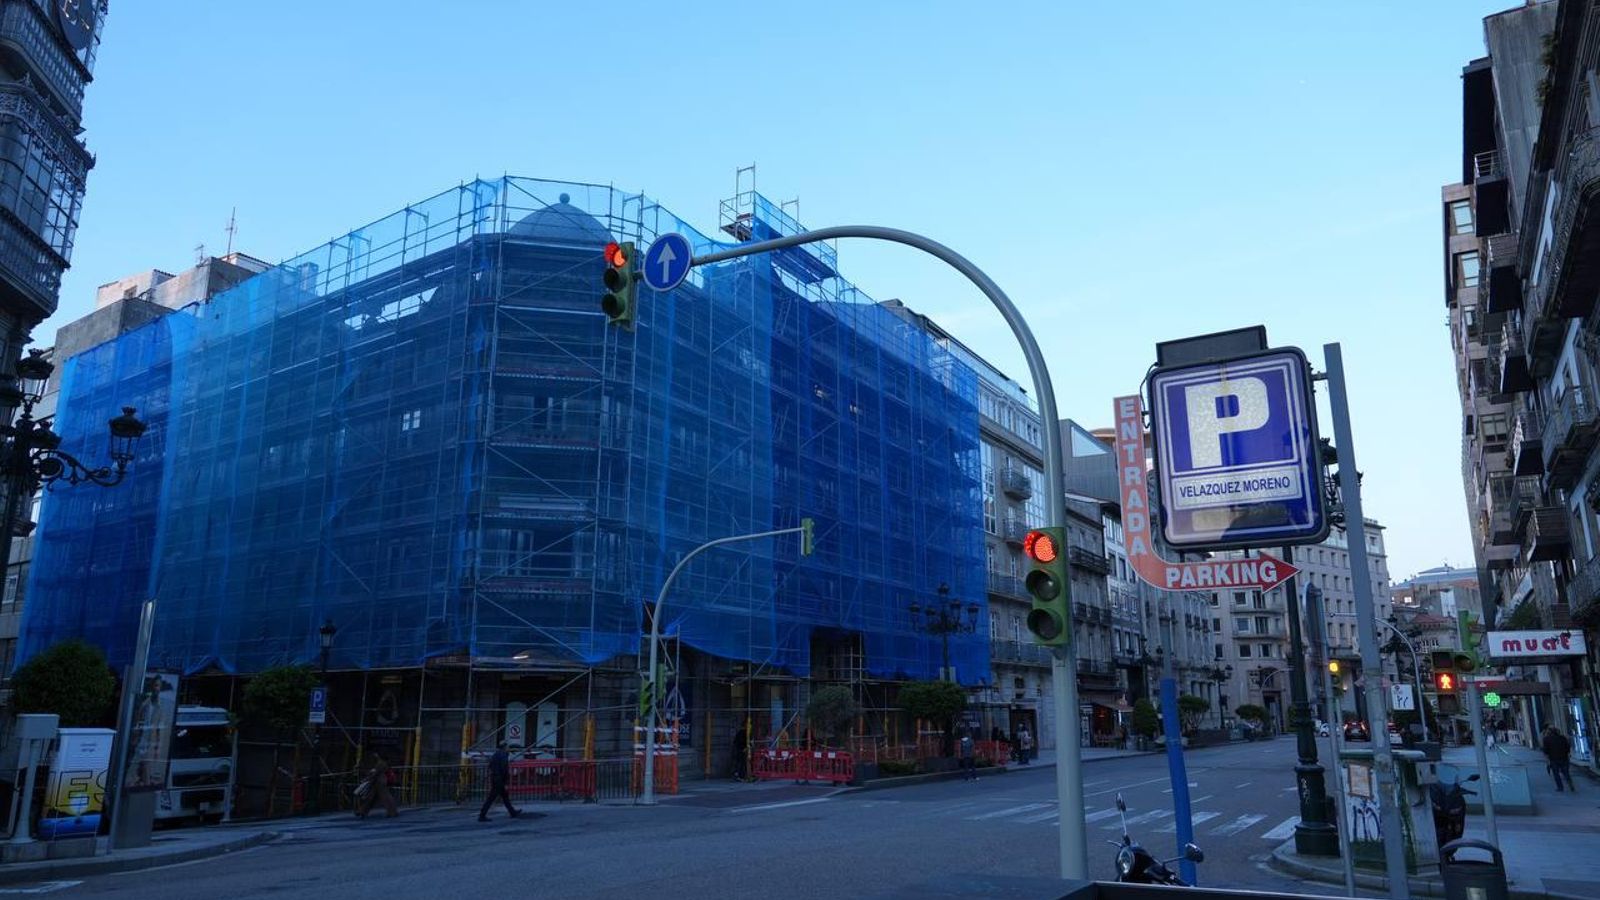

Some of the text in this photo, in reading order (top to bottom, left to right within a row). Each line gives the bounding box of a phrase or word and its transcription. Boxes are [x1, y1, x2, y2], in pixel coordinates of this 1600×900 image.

[1185, 377, 1270, 469] P
[1119, 399, 1146, 557] ENTRADA
[1180, 476, 1291, 498] VELAZQUEZ MORENO
[1165, 561, 1278, 587] PARKING
